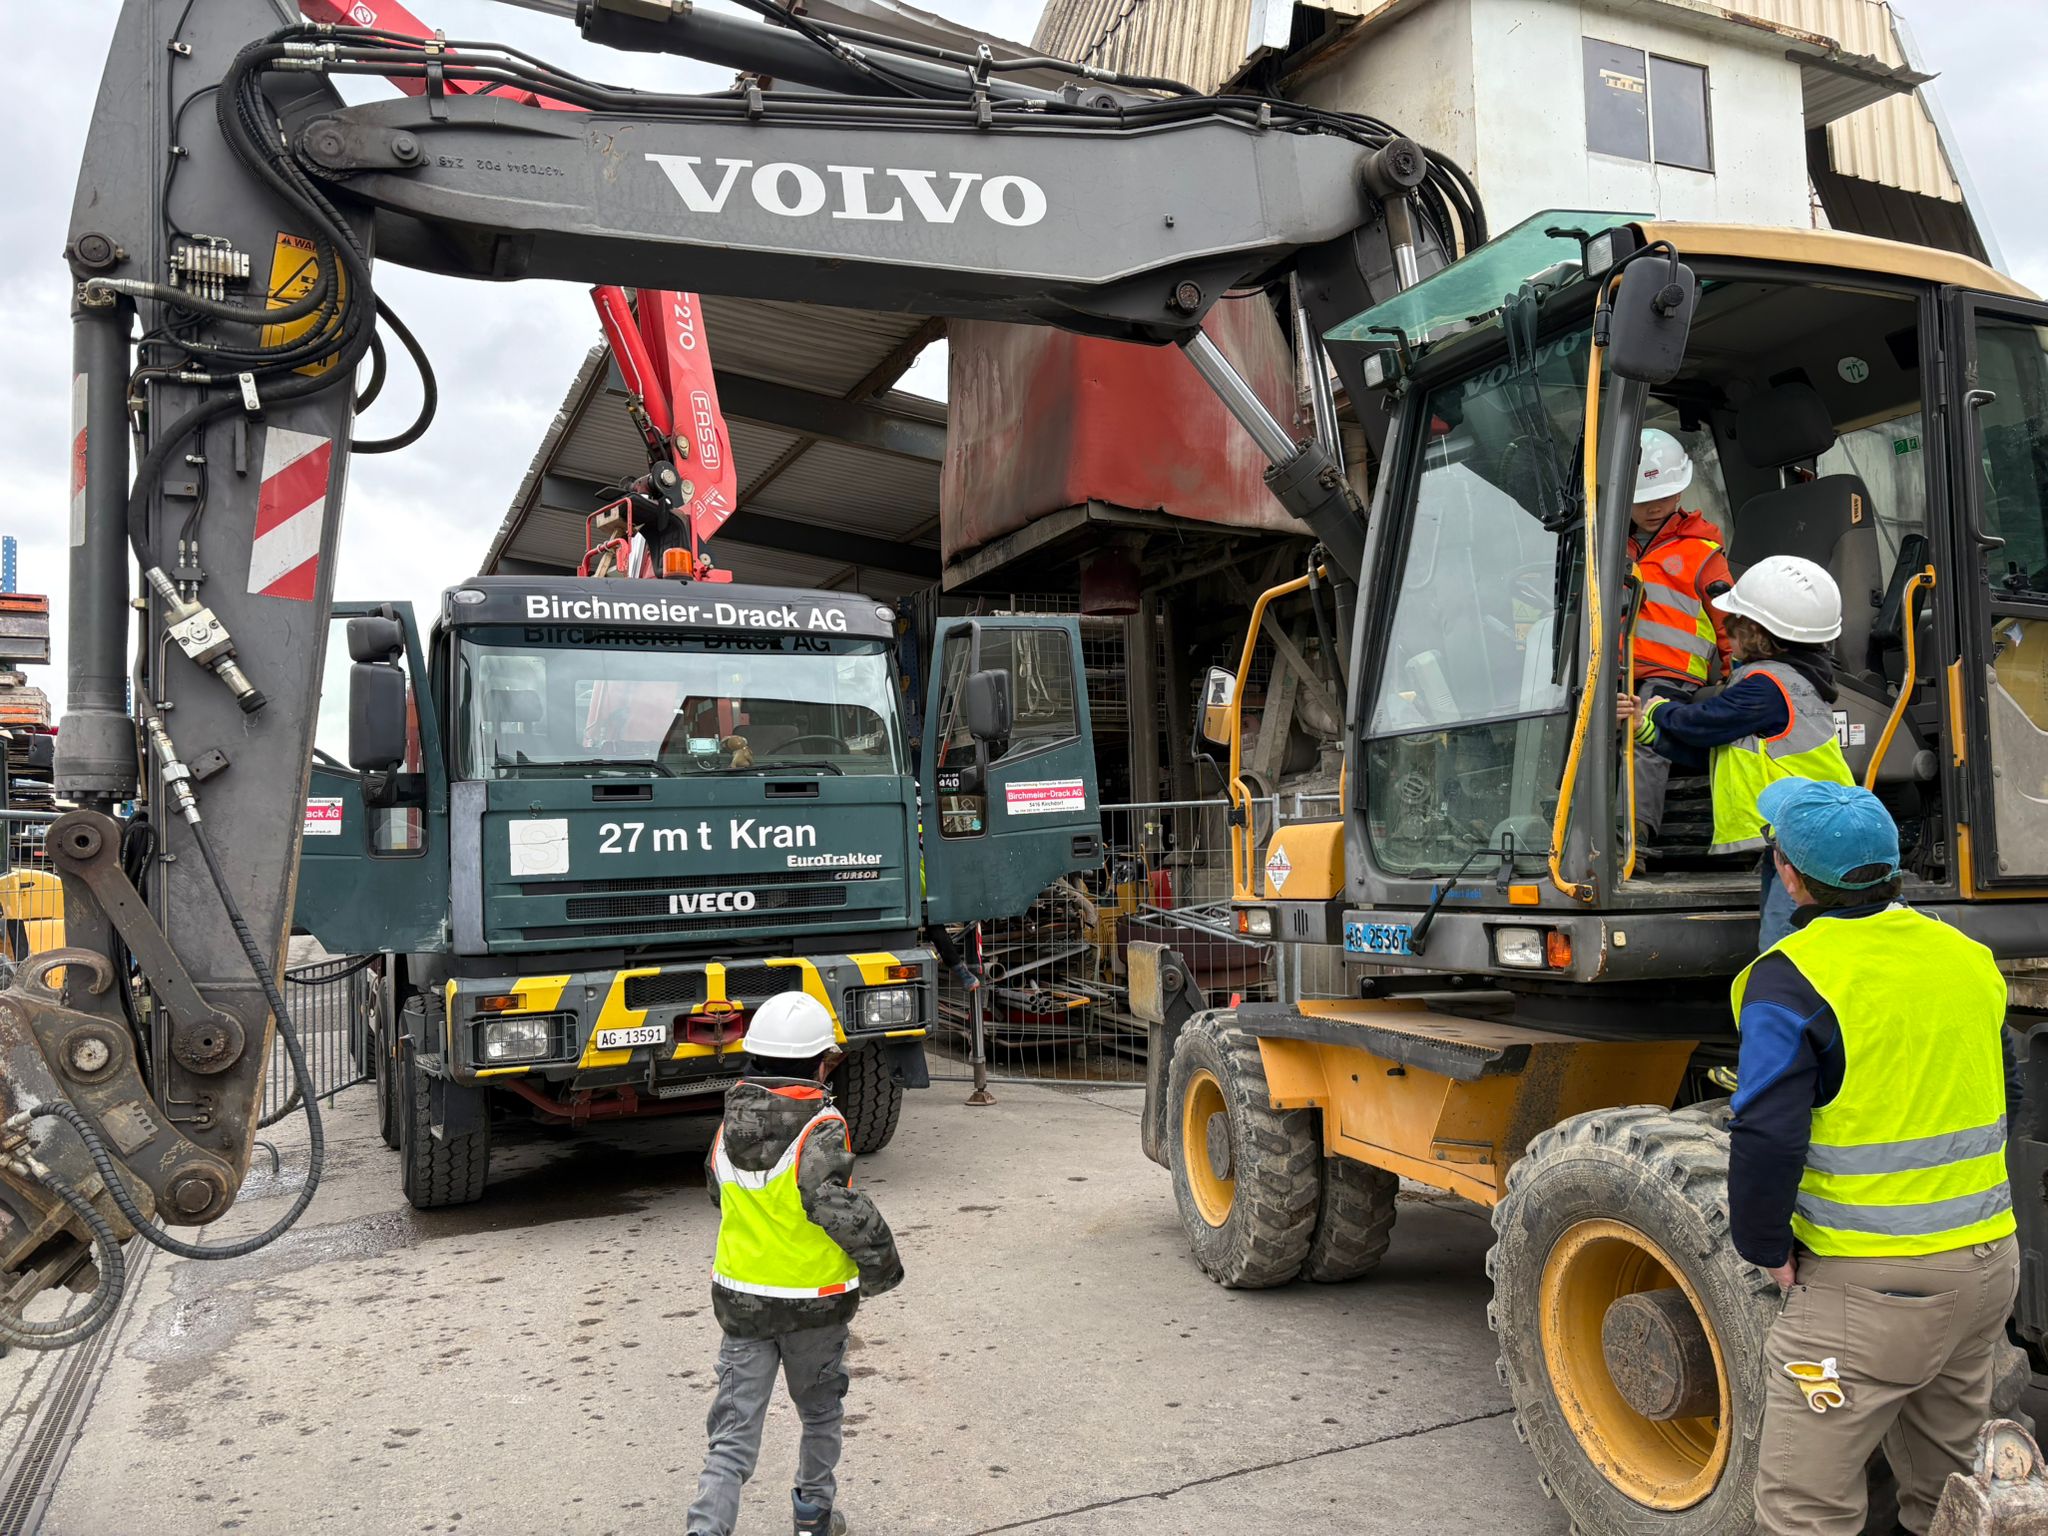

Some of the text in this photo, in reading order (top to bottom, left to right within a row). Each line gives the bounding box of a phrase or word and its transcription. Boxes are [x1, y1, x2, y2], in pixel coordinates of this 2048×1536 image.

[645, 153, 1047, 226] VOLVO
[694, 396, 717, 463] FASSI
[526, 595, 847, 632] Birchmeier-Drack AG
[1008, 789, 1082, 800] Birchmeier-Drack AG
[325, 808, 339, 818] AG
[599, 822, 645, 853] 27
[730, 819, 816, 849] Kran
[787, 853, 882, 867] EuroTrakker
[834, 870, 879, 880] CURSOR
[669, 891, 756, 914] IVECO
